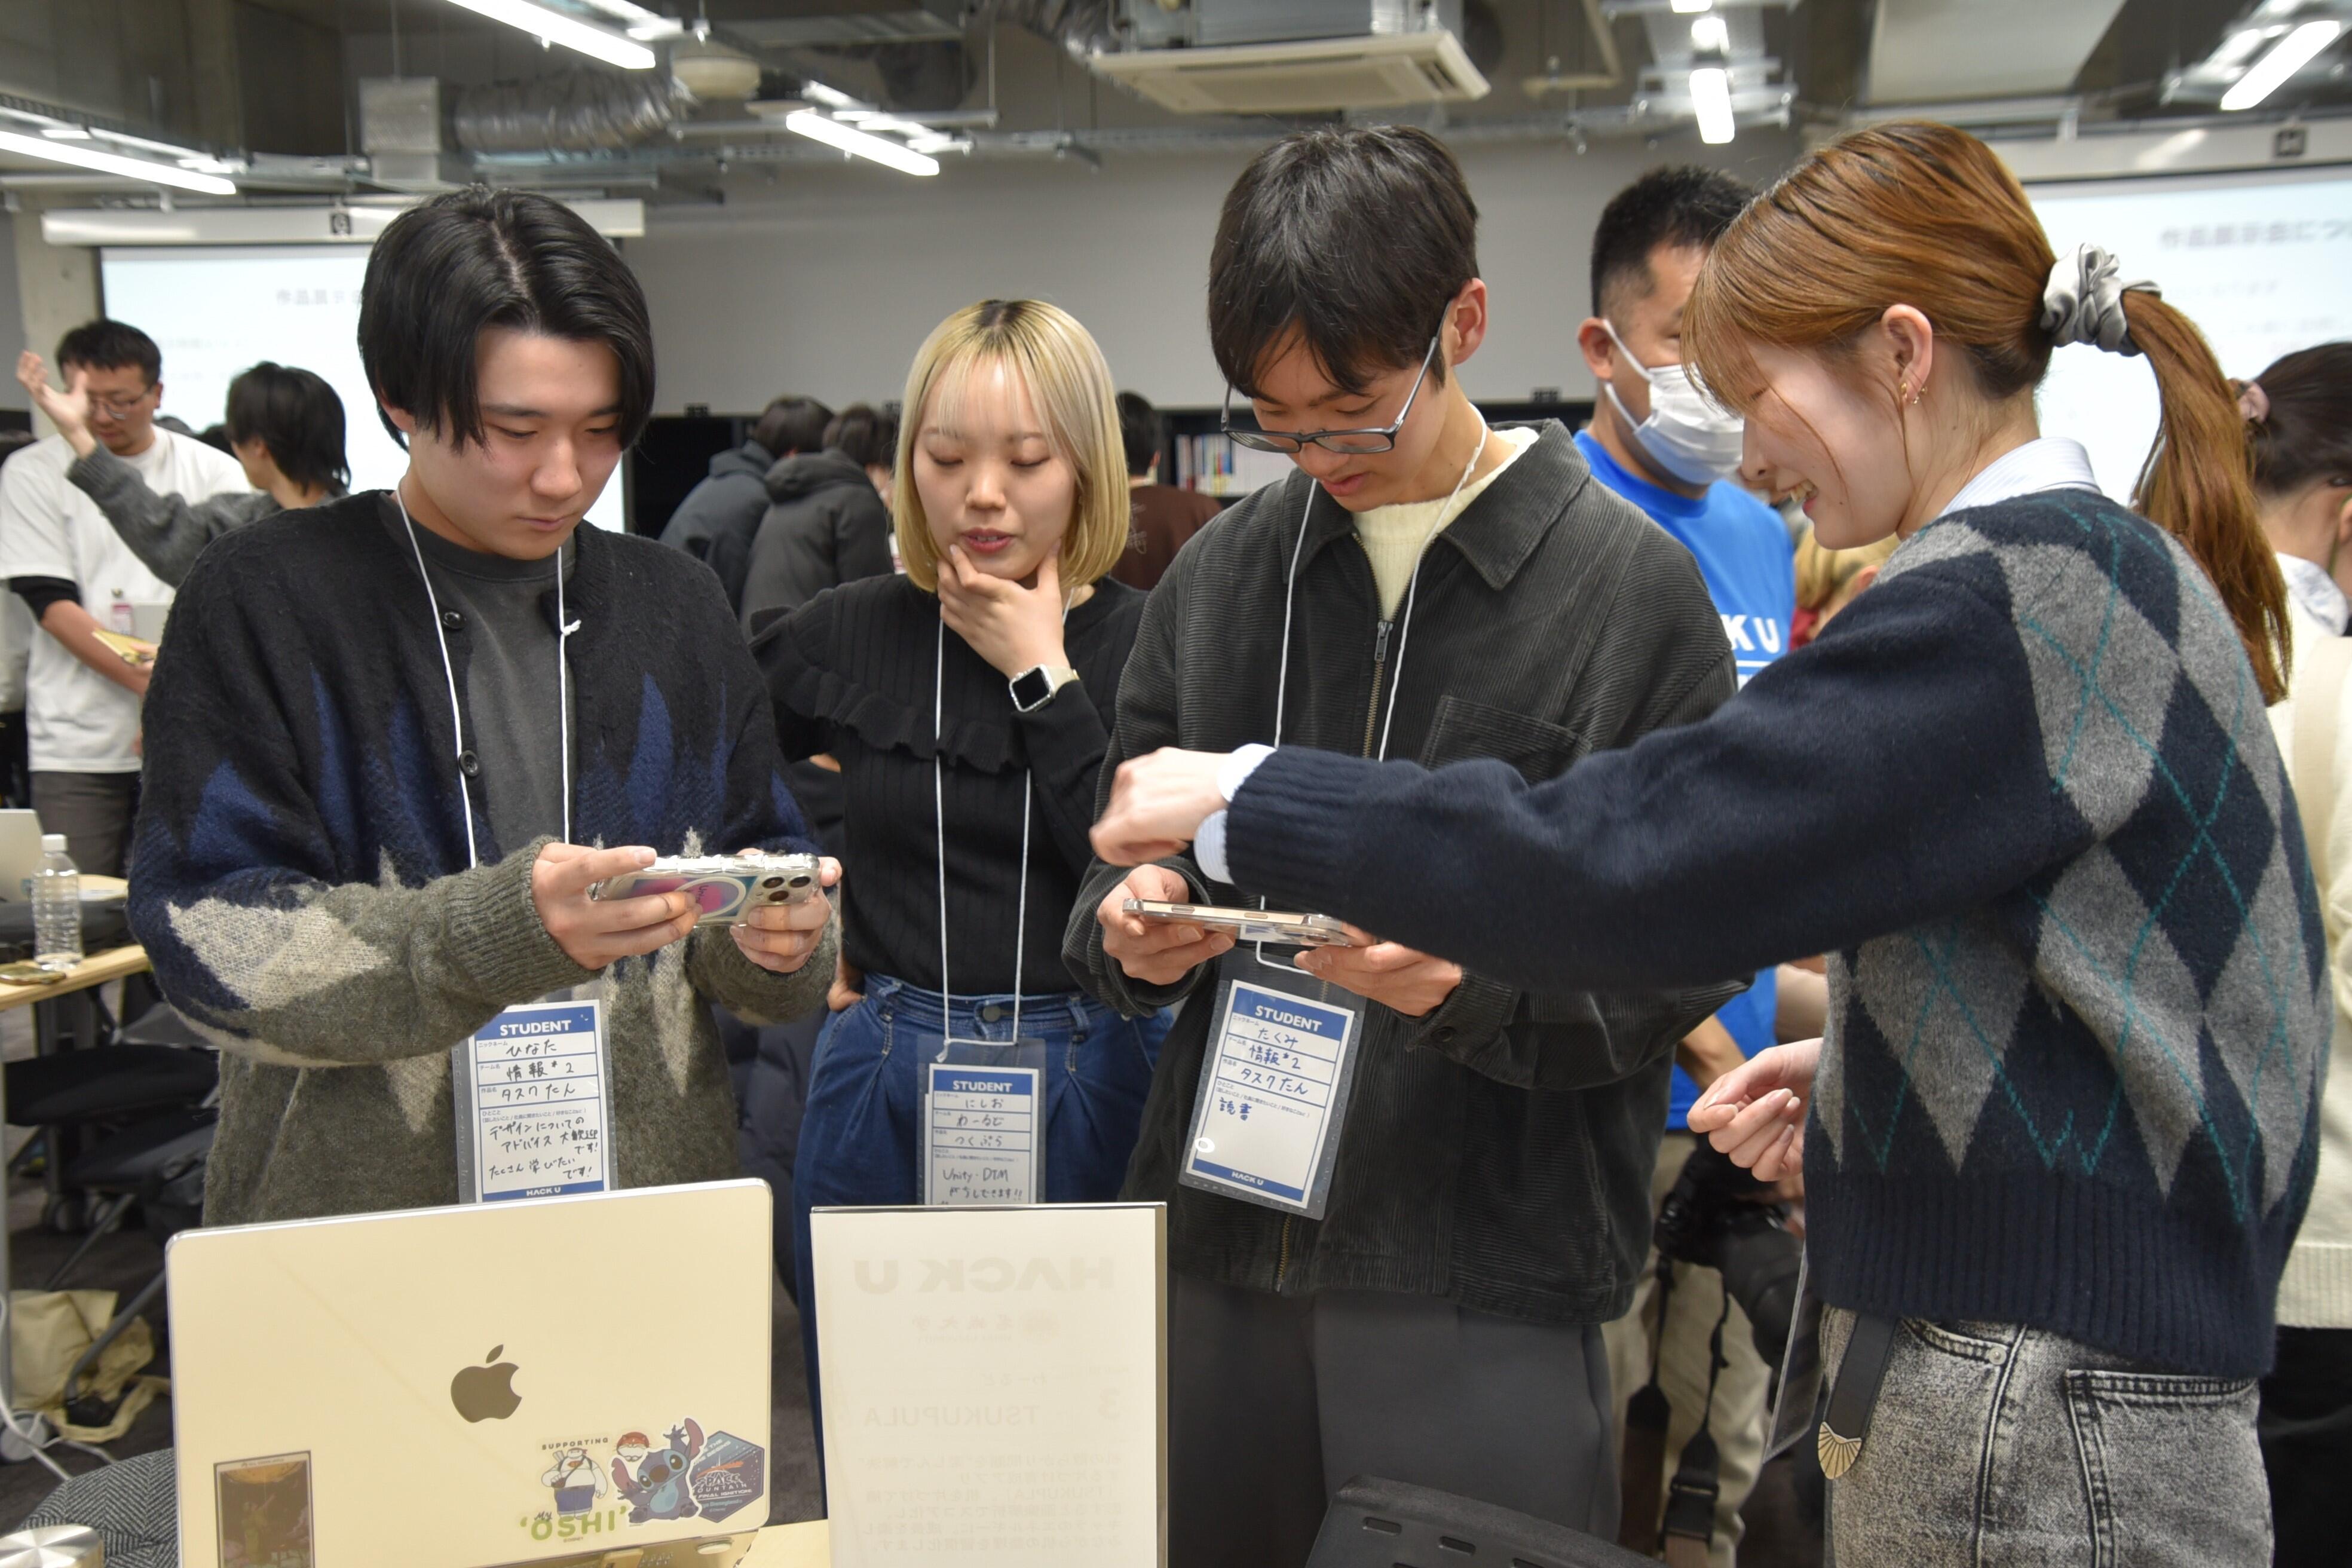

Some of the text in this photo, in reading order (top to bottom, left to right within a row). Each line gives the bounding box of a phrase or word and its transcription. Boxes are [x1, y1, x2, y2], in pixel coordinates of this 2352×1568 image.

[1255, 1004, 1323, 1032] STUDENT
[500, 1019, 572, 1037] STUDENT
[1257, 1027, 1298, 1049] たくみ
[506, 1039, 557, 1057] ひなた
[953, 1080, 1013, 1092] STUDENT
[1241, 1068, 1308, 1095] タスクたん
[502, 1083, 575, 1102] タスクたん
[965, 1098, 1004, 1109] にしお
[1219, 1097, 1252, 1121] 読書
[489, 1116, 584, 1140] デザインについての
[1231, 1171, 1256, 1184] HACK
[526, 1187, 553, 1196] HACK
[541, 1437, 609, 1450] SUPPORTING
[534, 1511, 553, 1521] MY
